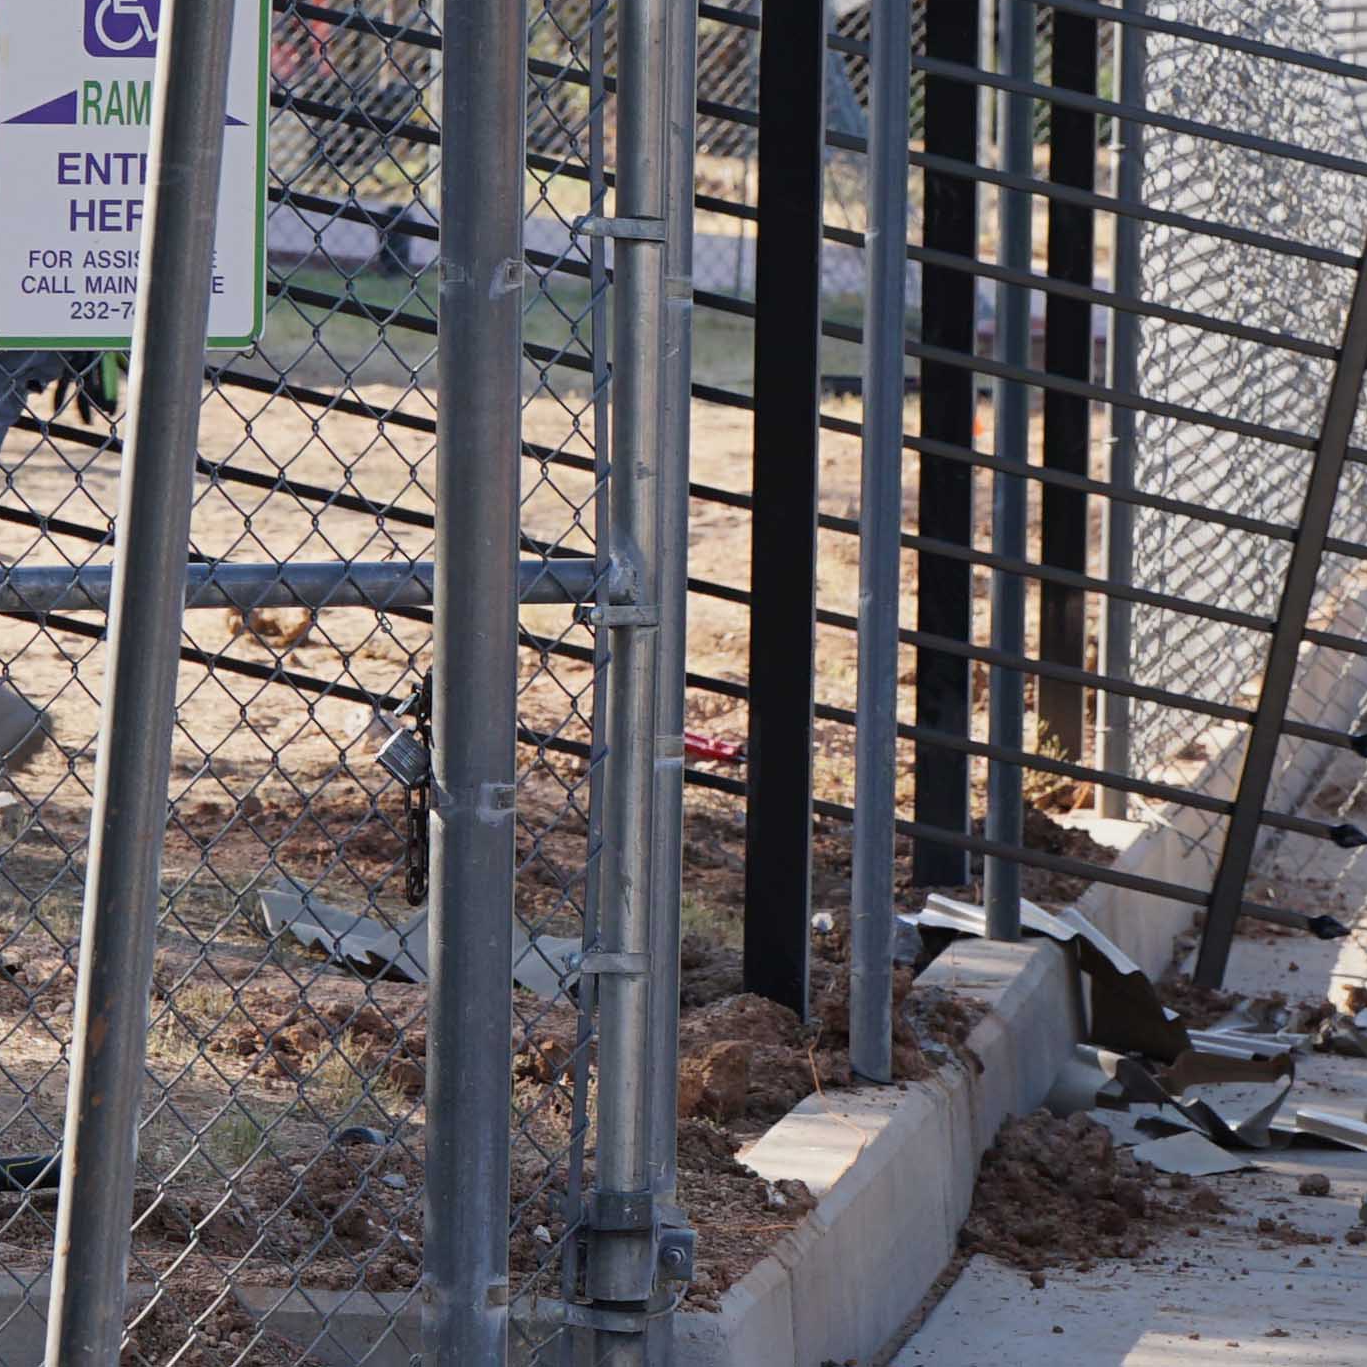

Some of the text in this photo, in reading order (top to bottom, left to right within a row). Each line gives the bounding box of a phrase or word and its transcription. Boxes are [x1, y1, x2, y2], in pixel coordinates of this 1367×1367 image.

[82, 80, 151, 126] RAM
[57, 152, 147, 185] ENT
[69, 199, 143, 232] HER
[28, 250, 73, 269] FOR
[21, 275, 75, 294] CALL
[70, 301, 135, 320] 232-7
